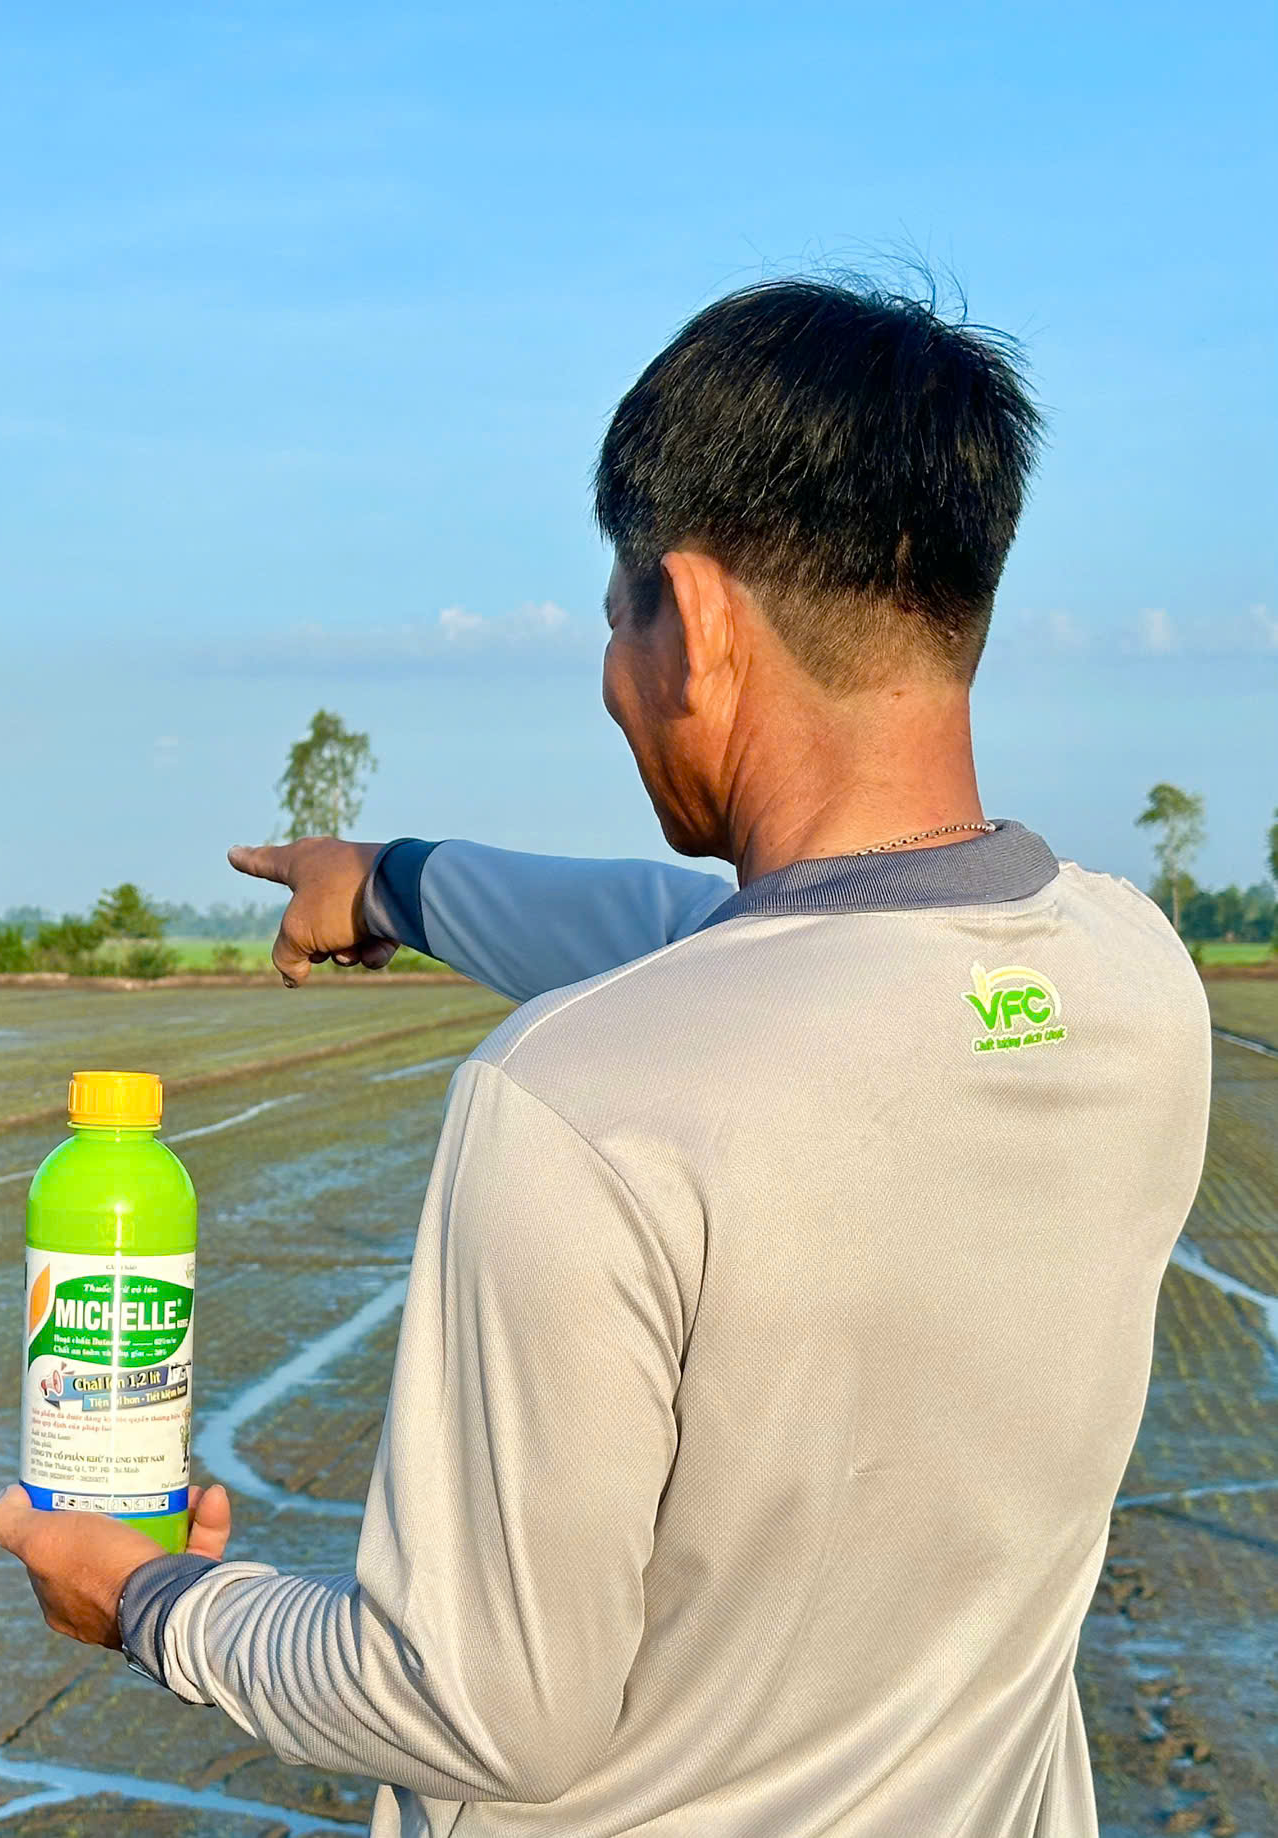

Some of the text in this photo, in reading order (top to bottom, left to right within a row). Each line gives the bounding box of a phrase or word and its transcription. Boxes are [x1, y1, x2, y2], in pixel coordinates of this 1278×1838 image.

[965, 986, 1050, 1029] VFC
[55, 1298, 176, 1331] MICHELLE
[129, 1372, 147, 1388] 1,2
